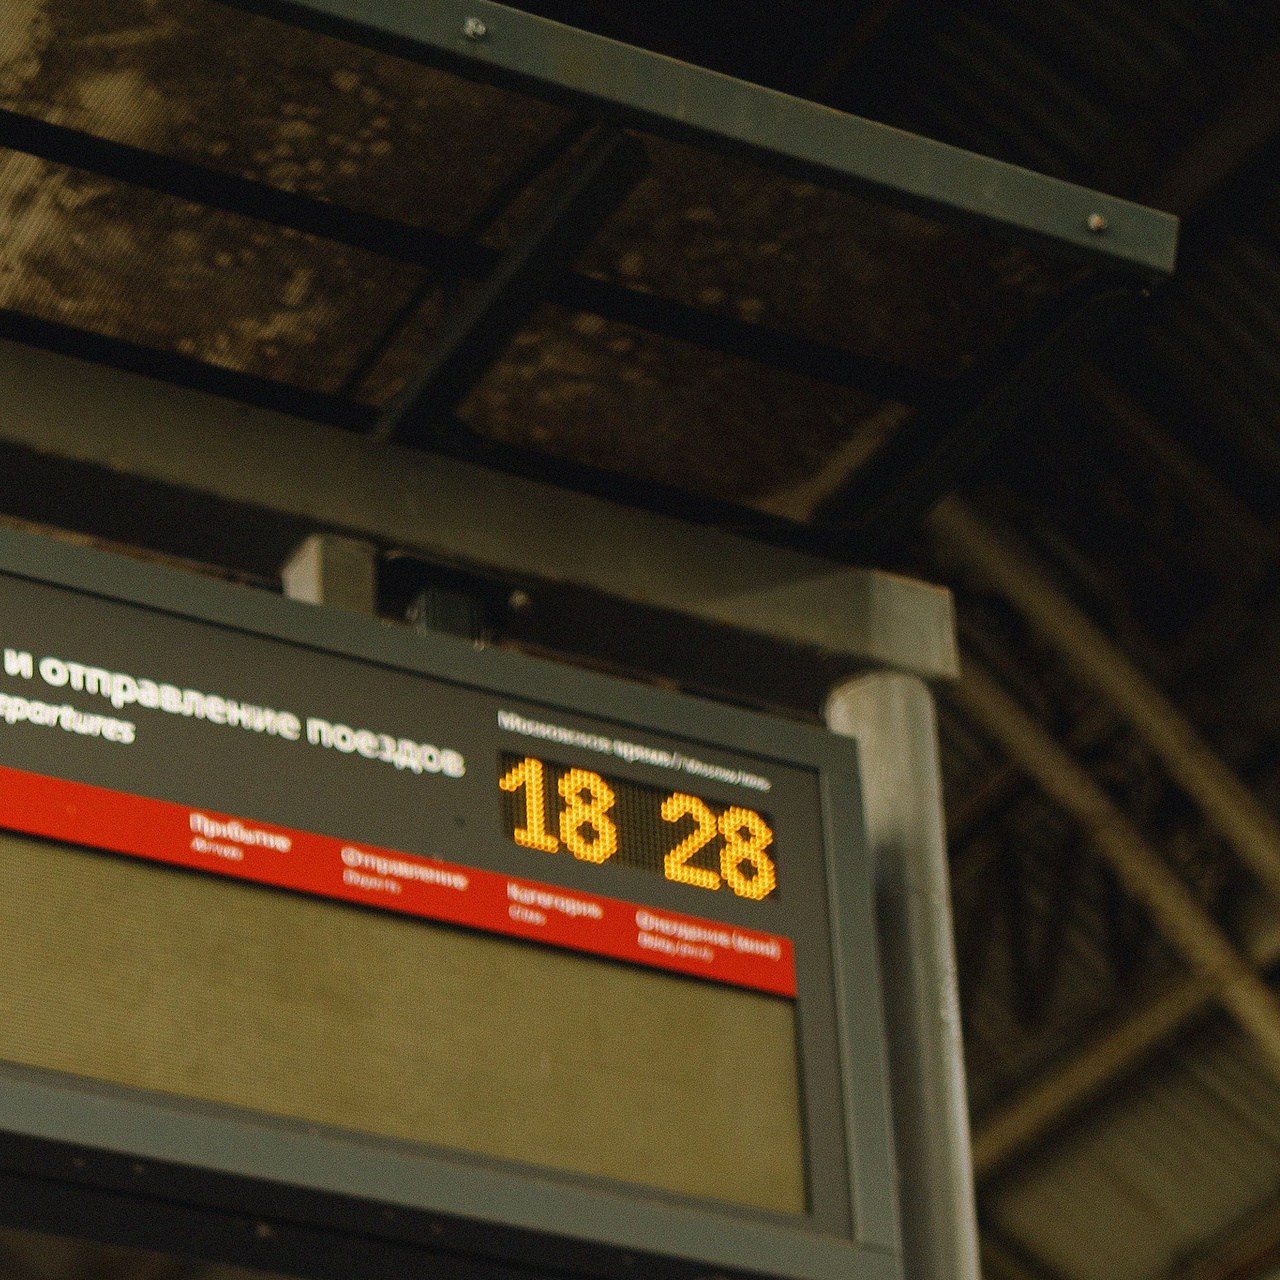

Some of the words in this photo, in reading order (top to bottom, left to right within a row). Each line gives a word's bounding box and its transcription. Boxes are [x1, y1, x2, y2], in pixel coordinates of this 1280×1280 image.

[3, 648, 34, 680] и
[38, 656, 302, 741] отправление
[306, 717, 467, 778] поездов
[499, 757, 618, 865] 18
[661, 792, 777, 900] 28
